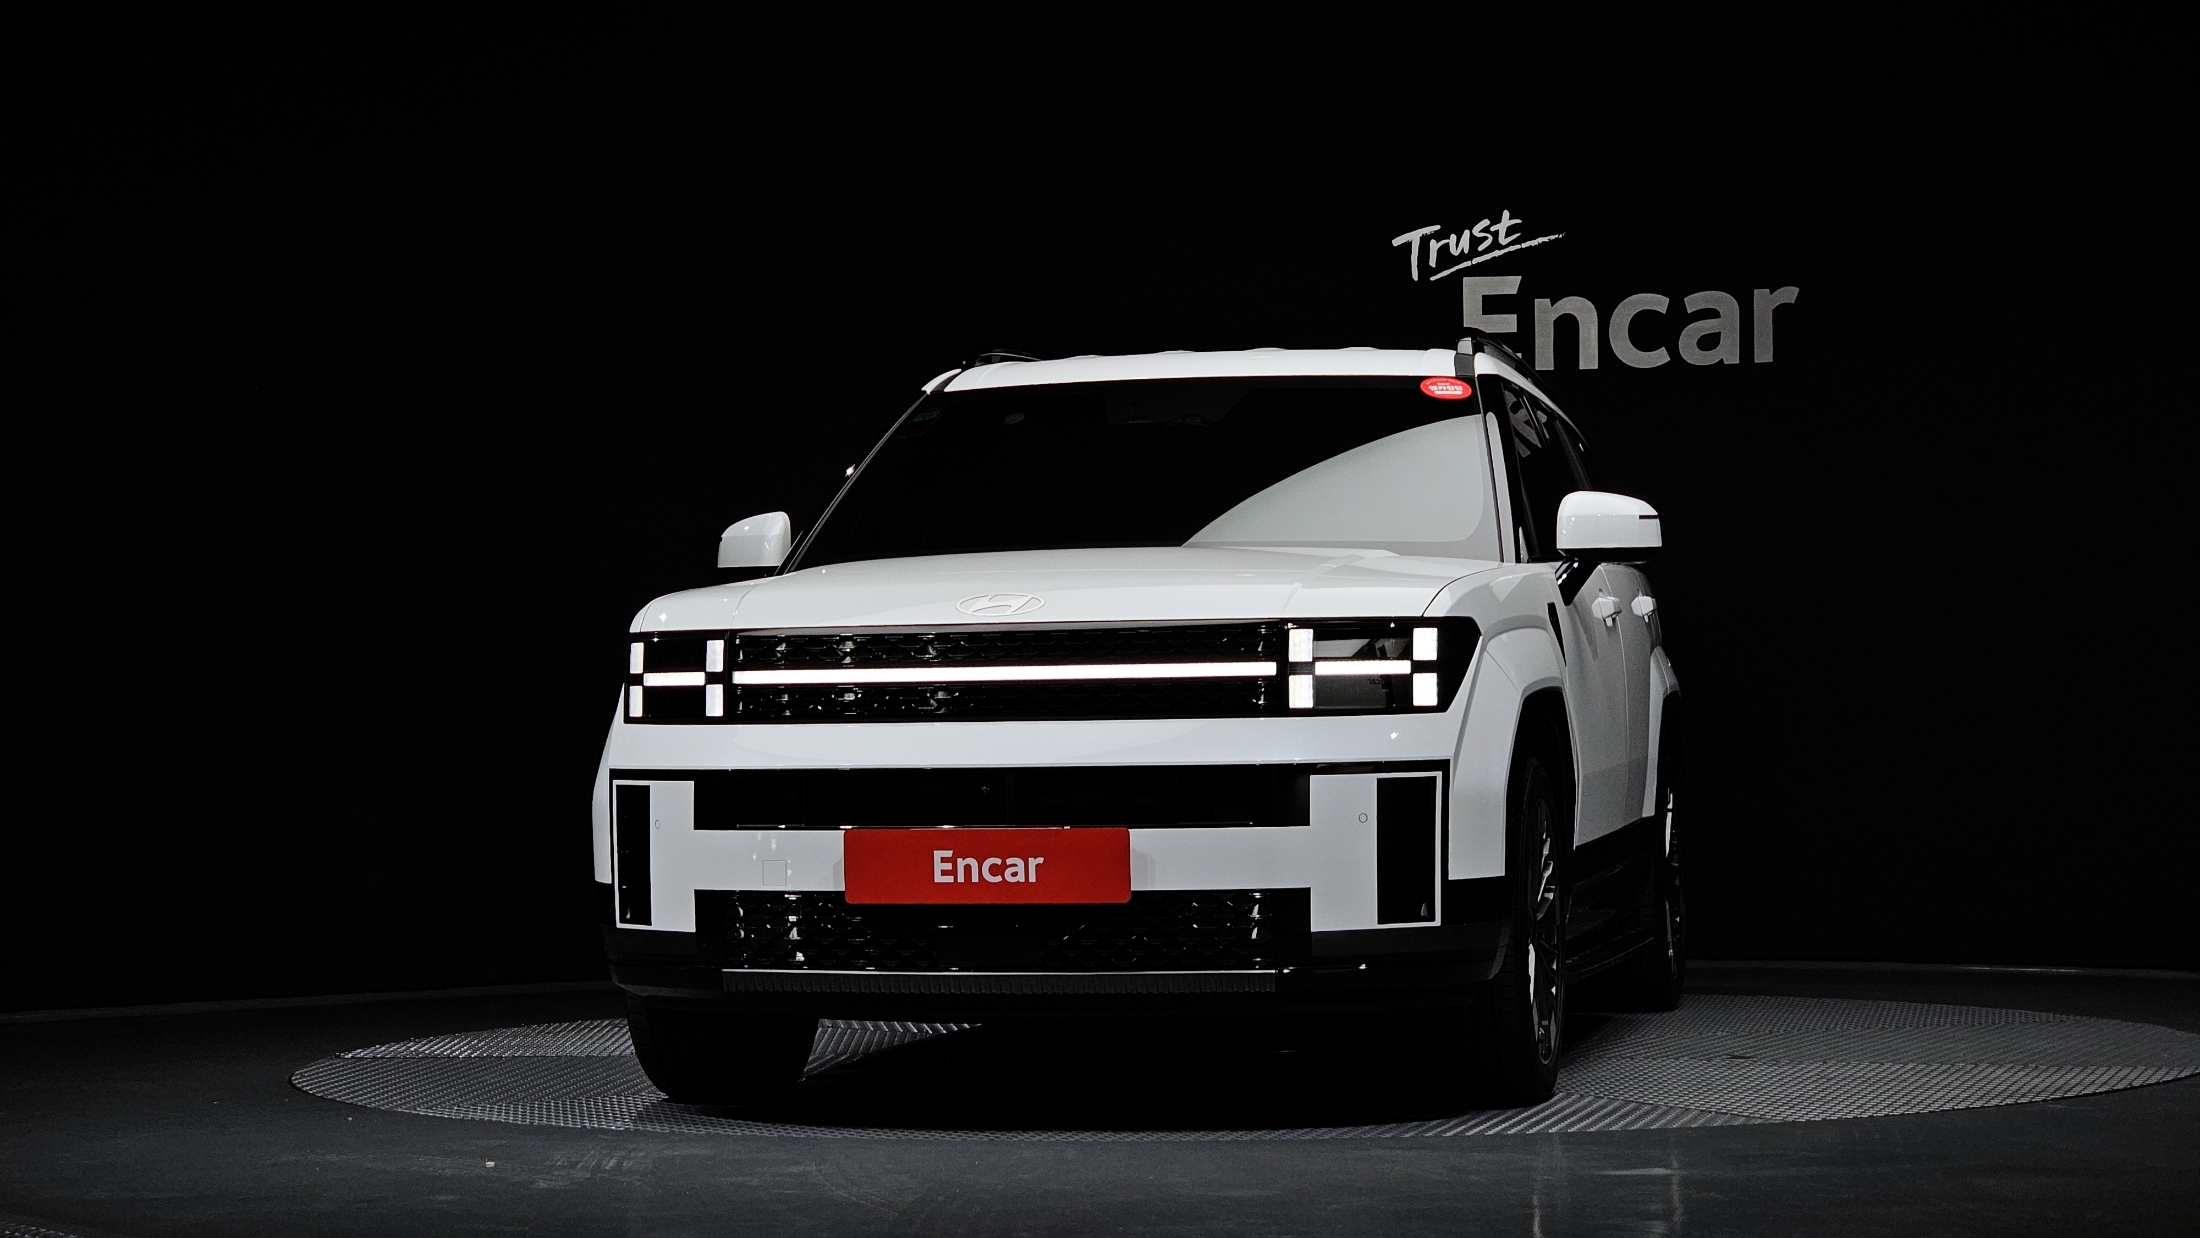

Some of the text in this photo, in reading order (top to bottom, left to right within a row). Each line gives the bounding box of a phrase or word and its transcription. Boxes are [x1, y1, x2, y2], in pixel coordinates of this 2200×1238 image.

[1392, 209, 1523, 282] Trust
[1462, 275, 1800, 371] Encar
[933, 850, 1045, 883] Encar
